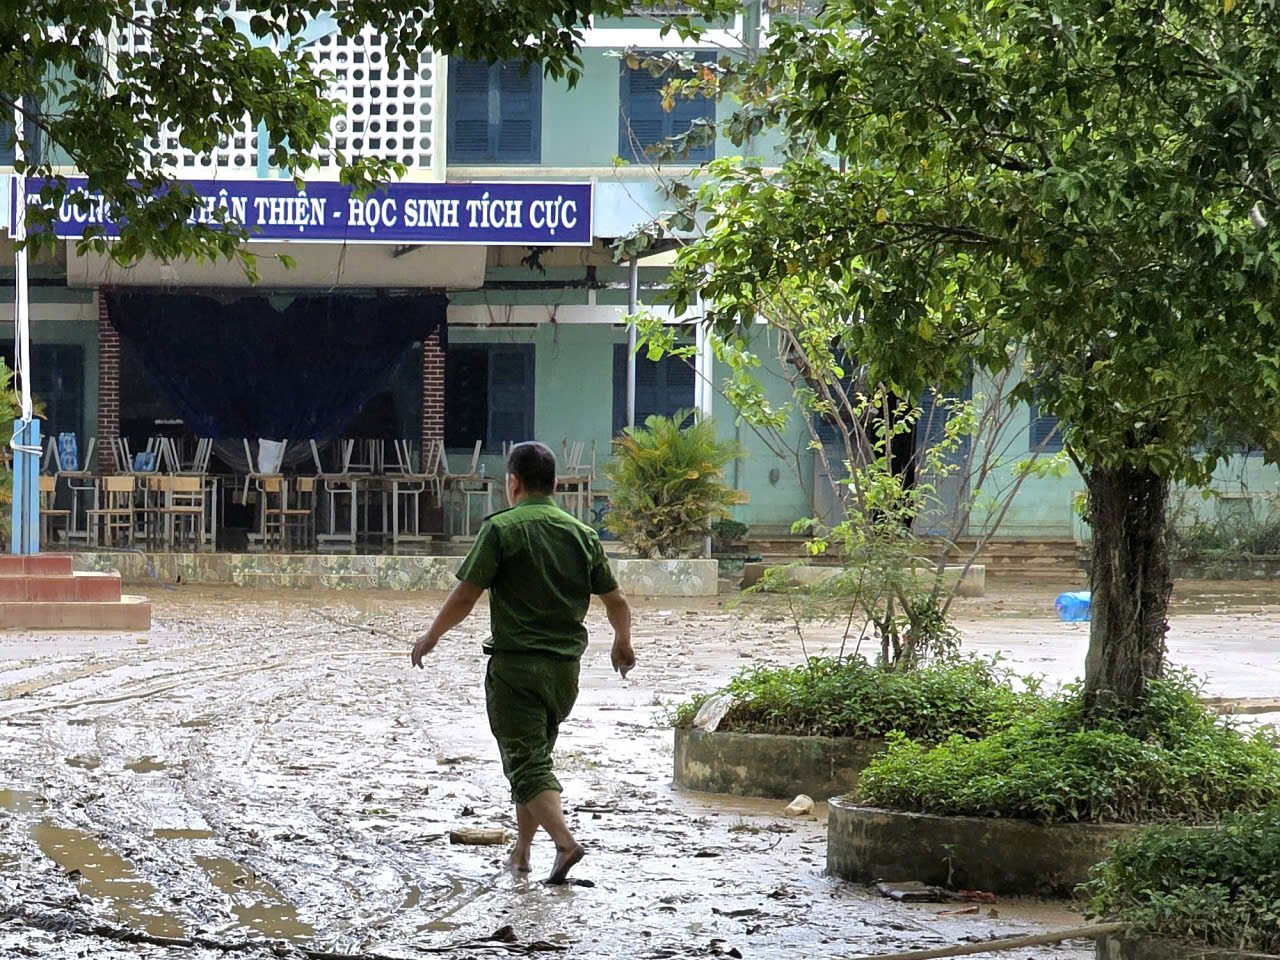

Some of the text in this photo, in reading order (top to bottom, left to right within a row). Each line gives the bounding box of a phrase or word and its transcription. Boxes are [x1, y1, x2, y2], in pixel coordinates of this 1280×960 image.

[253, 190, 327, 232] THIỆN
[347, 198, 398, 233] HỌC
[404, 199, 460, 228] SINH
[466, 192, 523, 229] TÍCH
[529, 195, 577, 236] CỰC
